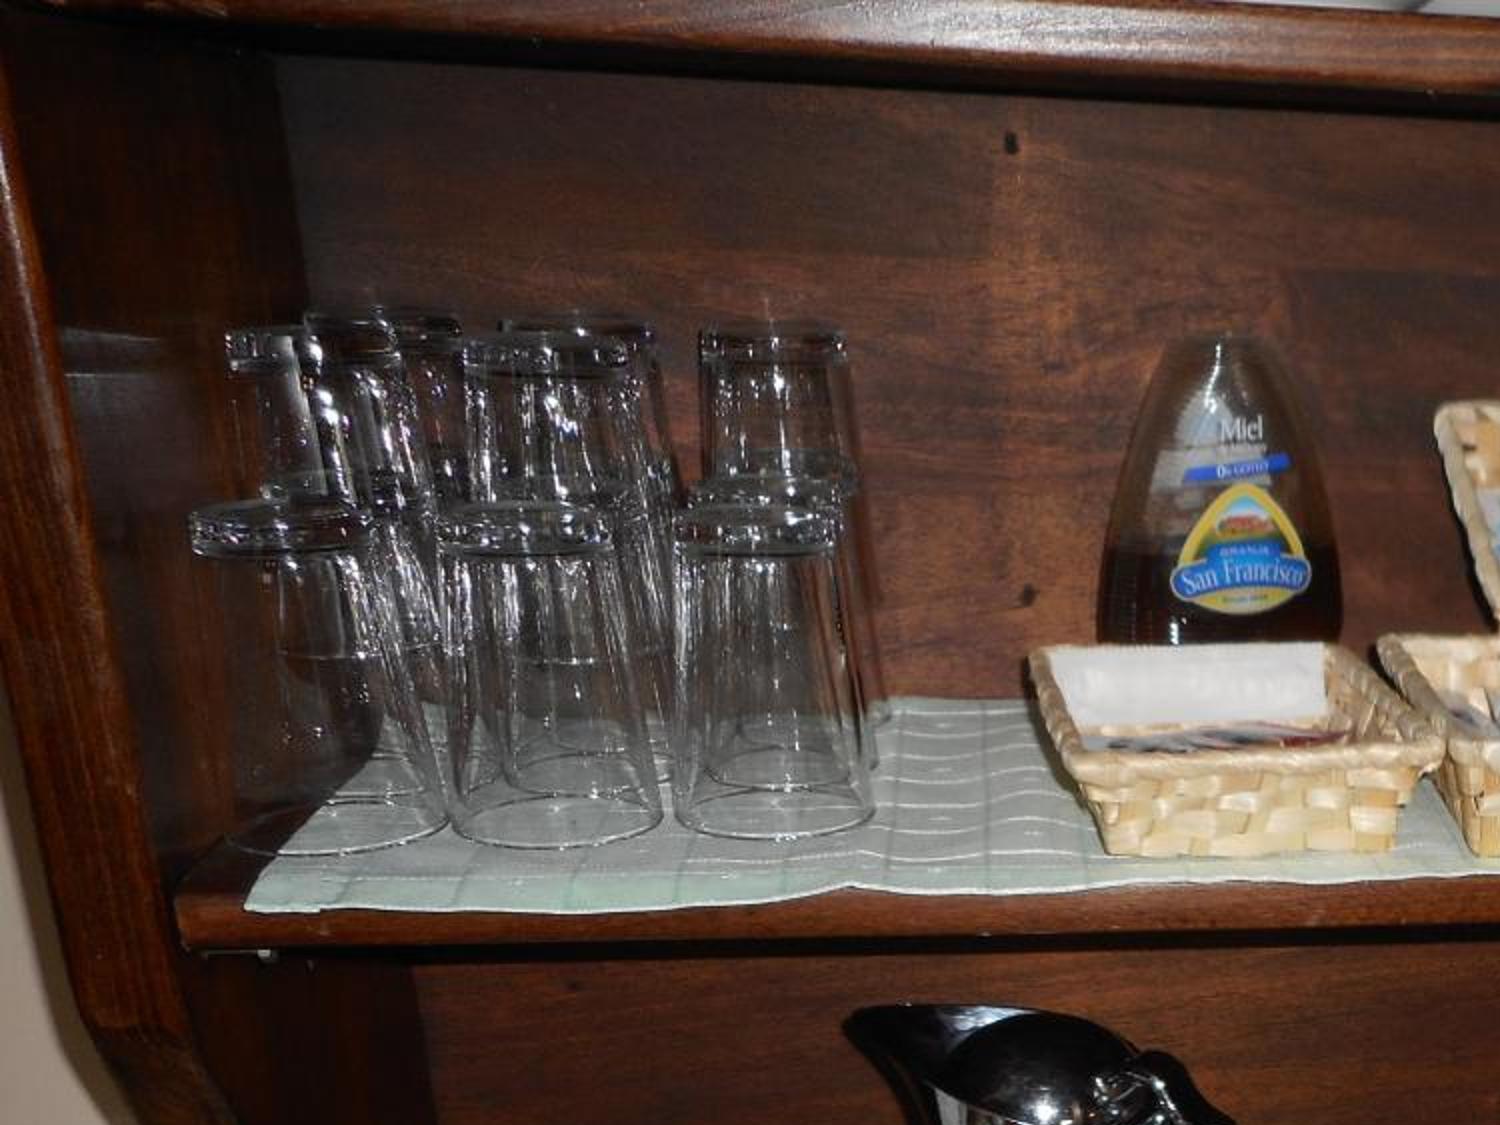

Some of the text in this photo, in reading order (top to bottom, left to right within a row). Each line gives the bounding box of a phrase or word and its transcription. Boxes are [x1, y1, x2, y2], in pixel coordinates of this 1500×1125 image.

[1220, 414, 1264, 442] Miel
[1181, 556, 1303, 596] San Francisco
